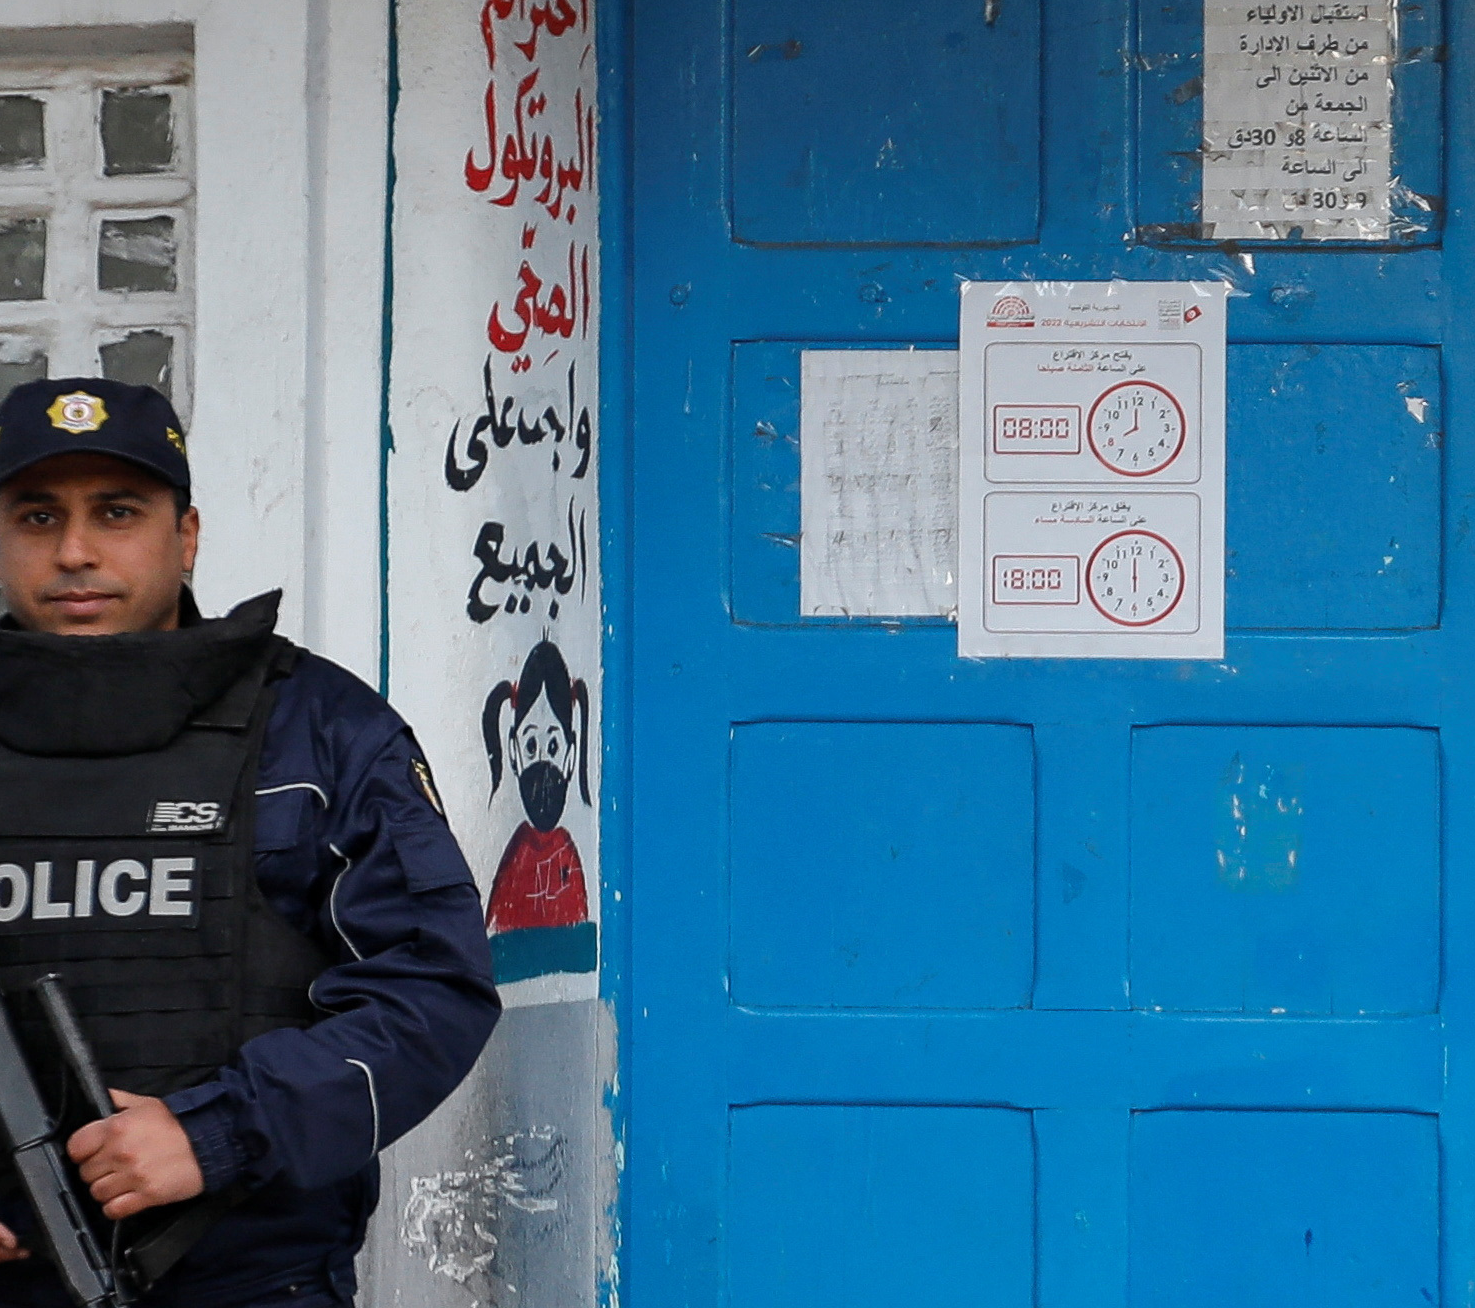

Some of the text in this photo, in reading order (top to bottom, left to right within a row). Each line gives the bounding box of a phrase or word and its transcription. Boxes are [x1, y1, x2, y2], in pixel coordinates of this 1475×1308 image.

[1296, 33, 1339, 56] طرف
[1345, 38, 1368, 55] من
[1345, 68, 1369, 85] من
[1286, 92, 1368, 116] الجمعة من
[1312, 122, 1367, 142] الساعة
[1281, 155, 1336, 174] الساعة
[1003, 418, 1070, 439] 08:00
[466, 494, 587, 624] الجميع
[1003, 568, 1062, 590] 18:00
